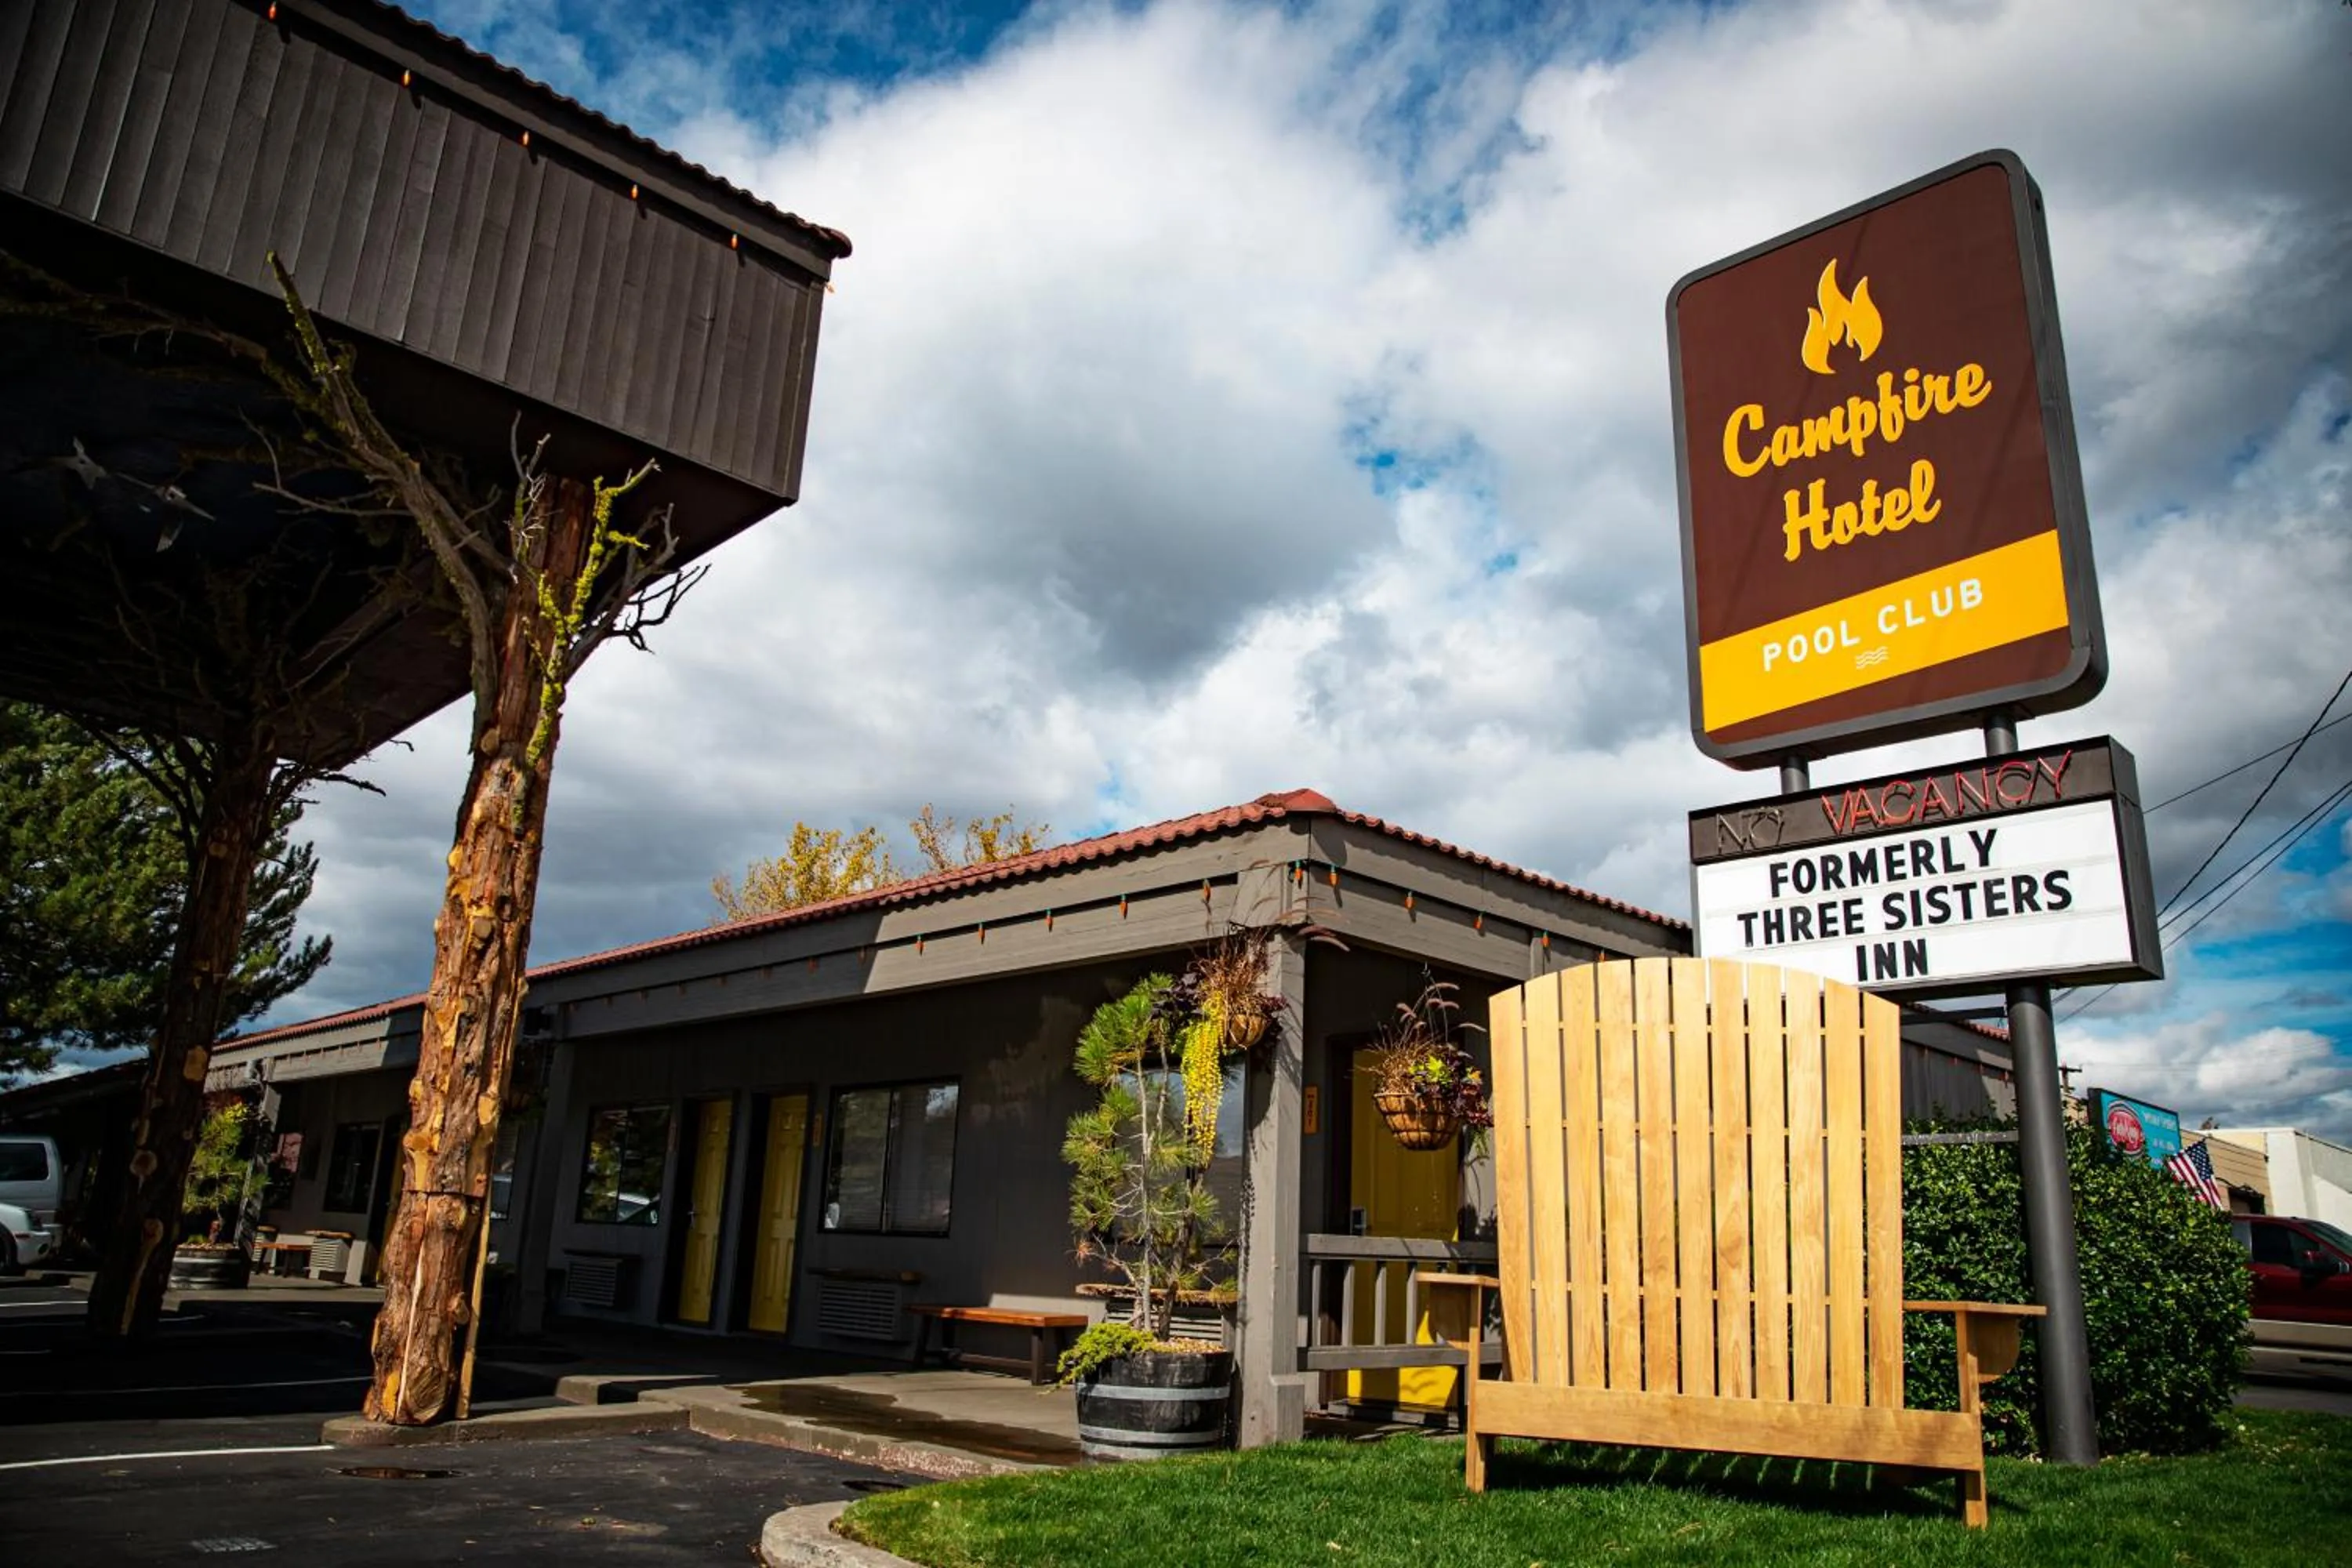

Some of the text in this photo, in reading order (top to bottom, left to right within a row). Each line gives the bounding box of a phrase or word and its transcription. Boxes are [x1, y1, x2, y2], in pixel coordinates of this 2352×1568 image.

[1723, 363, 1991, 477] Campfire
[1783, 459, 1940, 561] Hotel
[1763, 579, 1983, 671] POOL CLUB
[1716, 750, 2072, 853] NO VACANCY
[1737, 870, 2071, 947] THREE SISTERS
[1769, 829, 1997, 897] FORMERLY
[1857, 938, 1929, 982] INN
